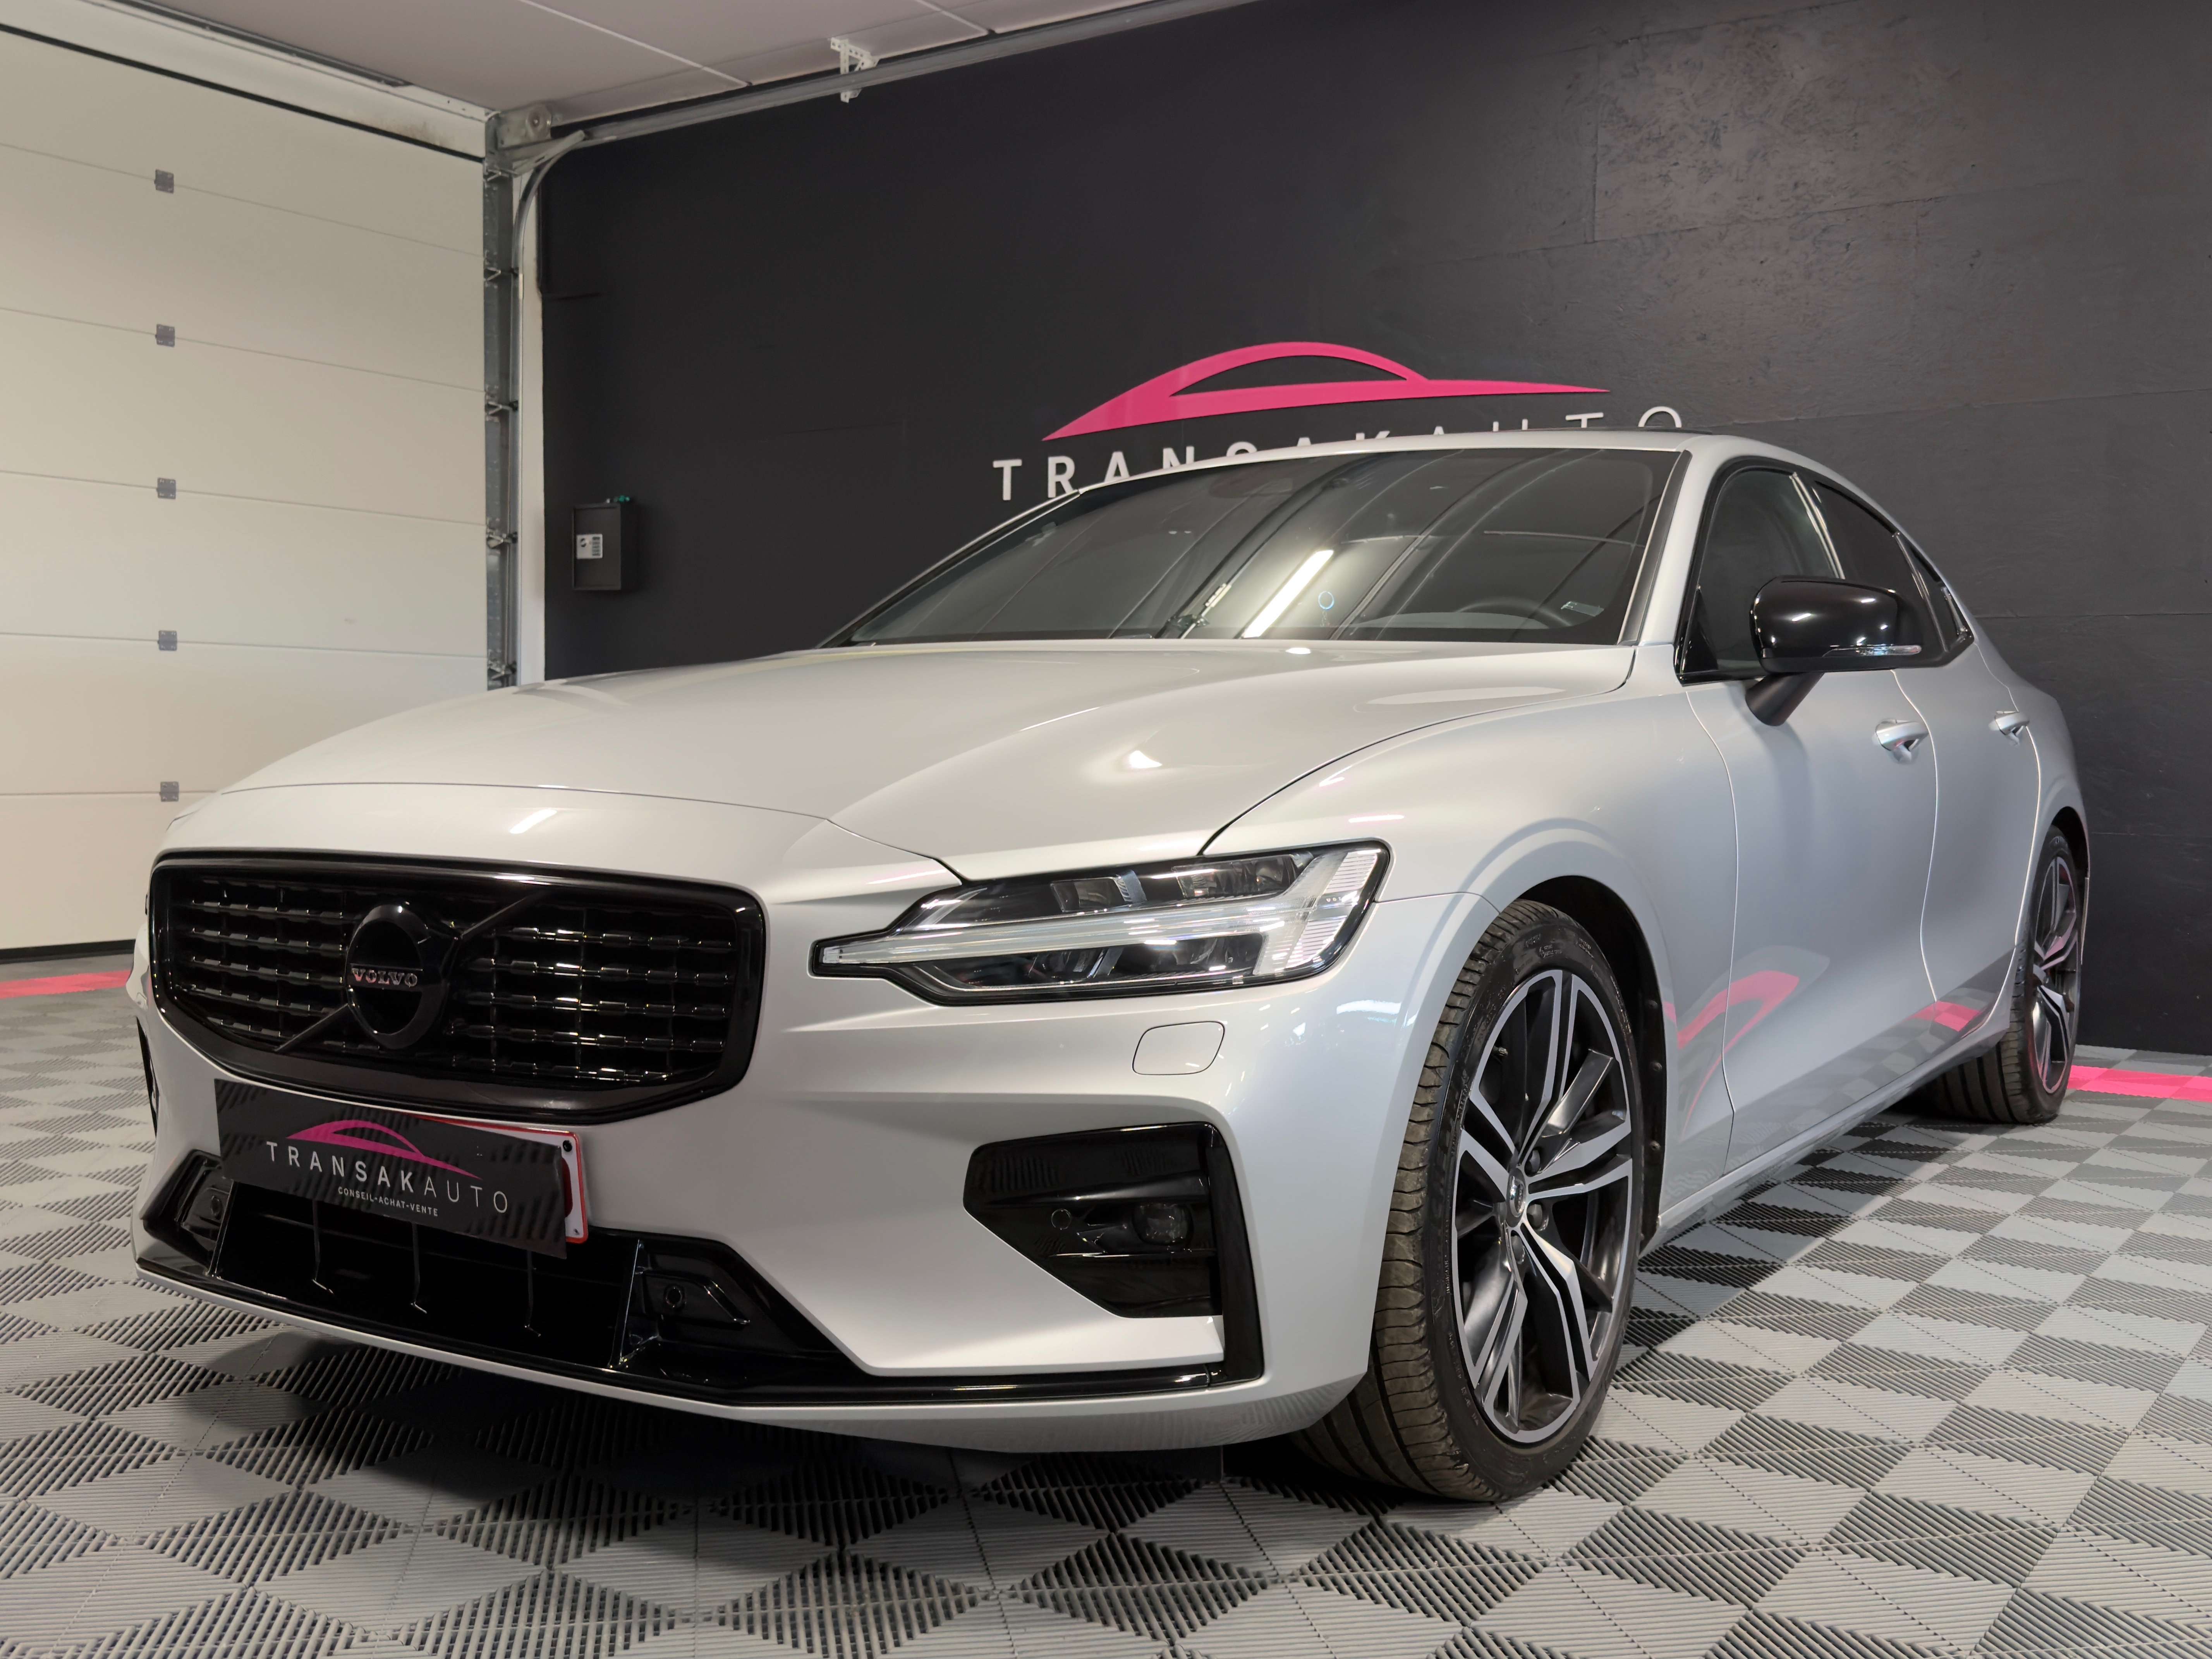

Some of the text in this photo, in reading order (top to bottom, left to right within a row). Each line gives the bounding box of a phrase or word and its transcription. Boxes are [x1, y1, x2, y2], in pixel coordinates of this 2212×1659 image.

[352, 969, 417, 987] VOLVO
[266, 1140, 508, 1214] TRANSAKAUTO
[338, 1187, 438, 1217] CONSEIL-ACHAT-VENTE
